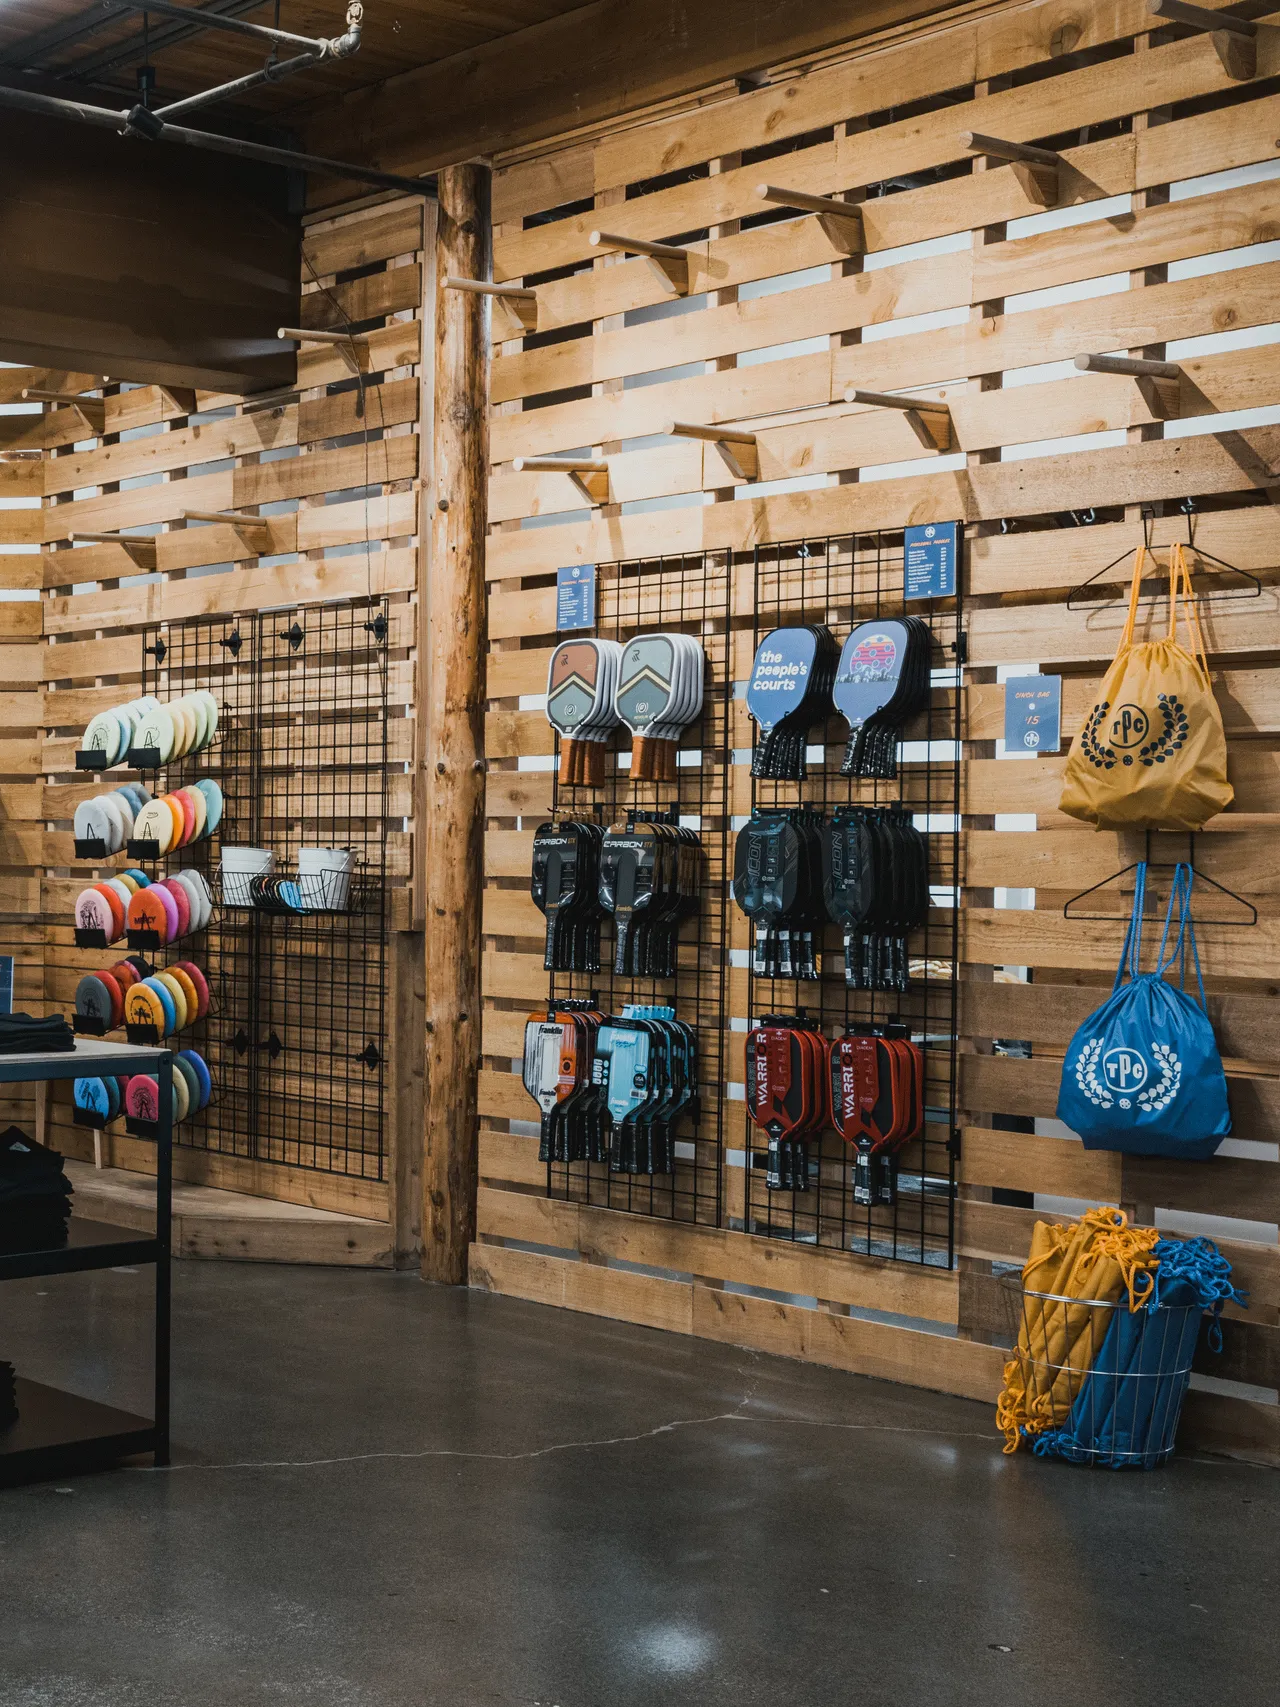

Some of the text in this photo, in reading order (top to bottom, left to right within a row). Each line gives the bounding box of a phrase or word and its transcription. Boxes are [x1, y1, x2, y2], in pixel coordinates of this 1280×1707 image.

[761, 650, 782, 664] the
[756, 661, 808, 678] people's
[753, 678, 796, 690] courts
[534, 838, 568, 846] CARBON
[603, 840, 643, 848] CARBON
[746, 832, 762, 877] ICON
[831, 831, 843, 879] ICON
[538, 1024, 563, 1035] Franklin
[757, 1033, 769, 1106] WARRIOR
[1106, 1054, 1143, 1088] TPC
[841, 1042, 855, 1119] WARRIOR
